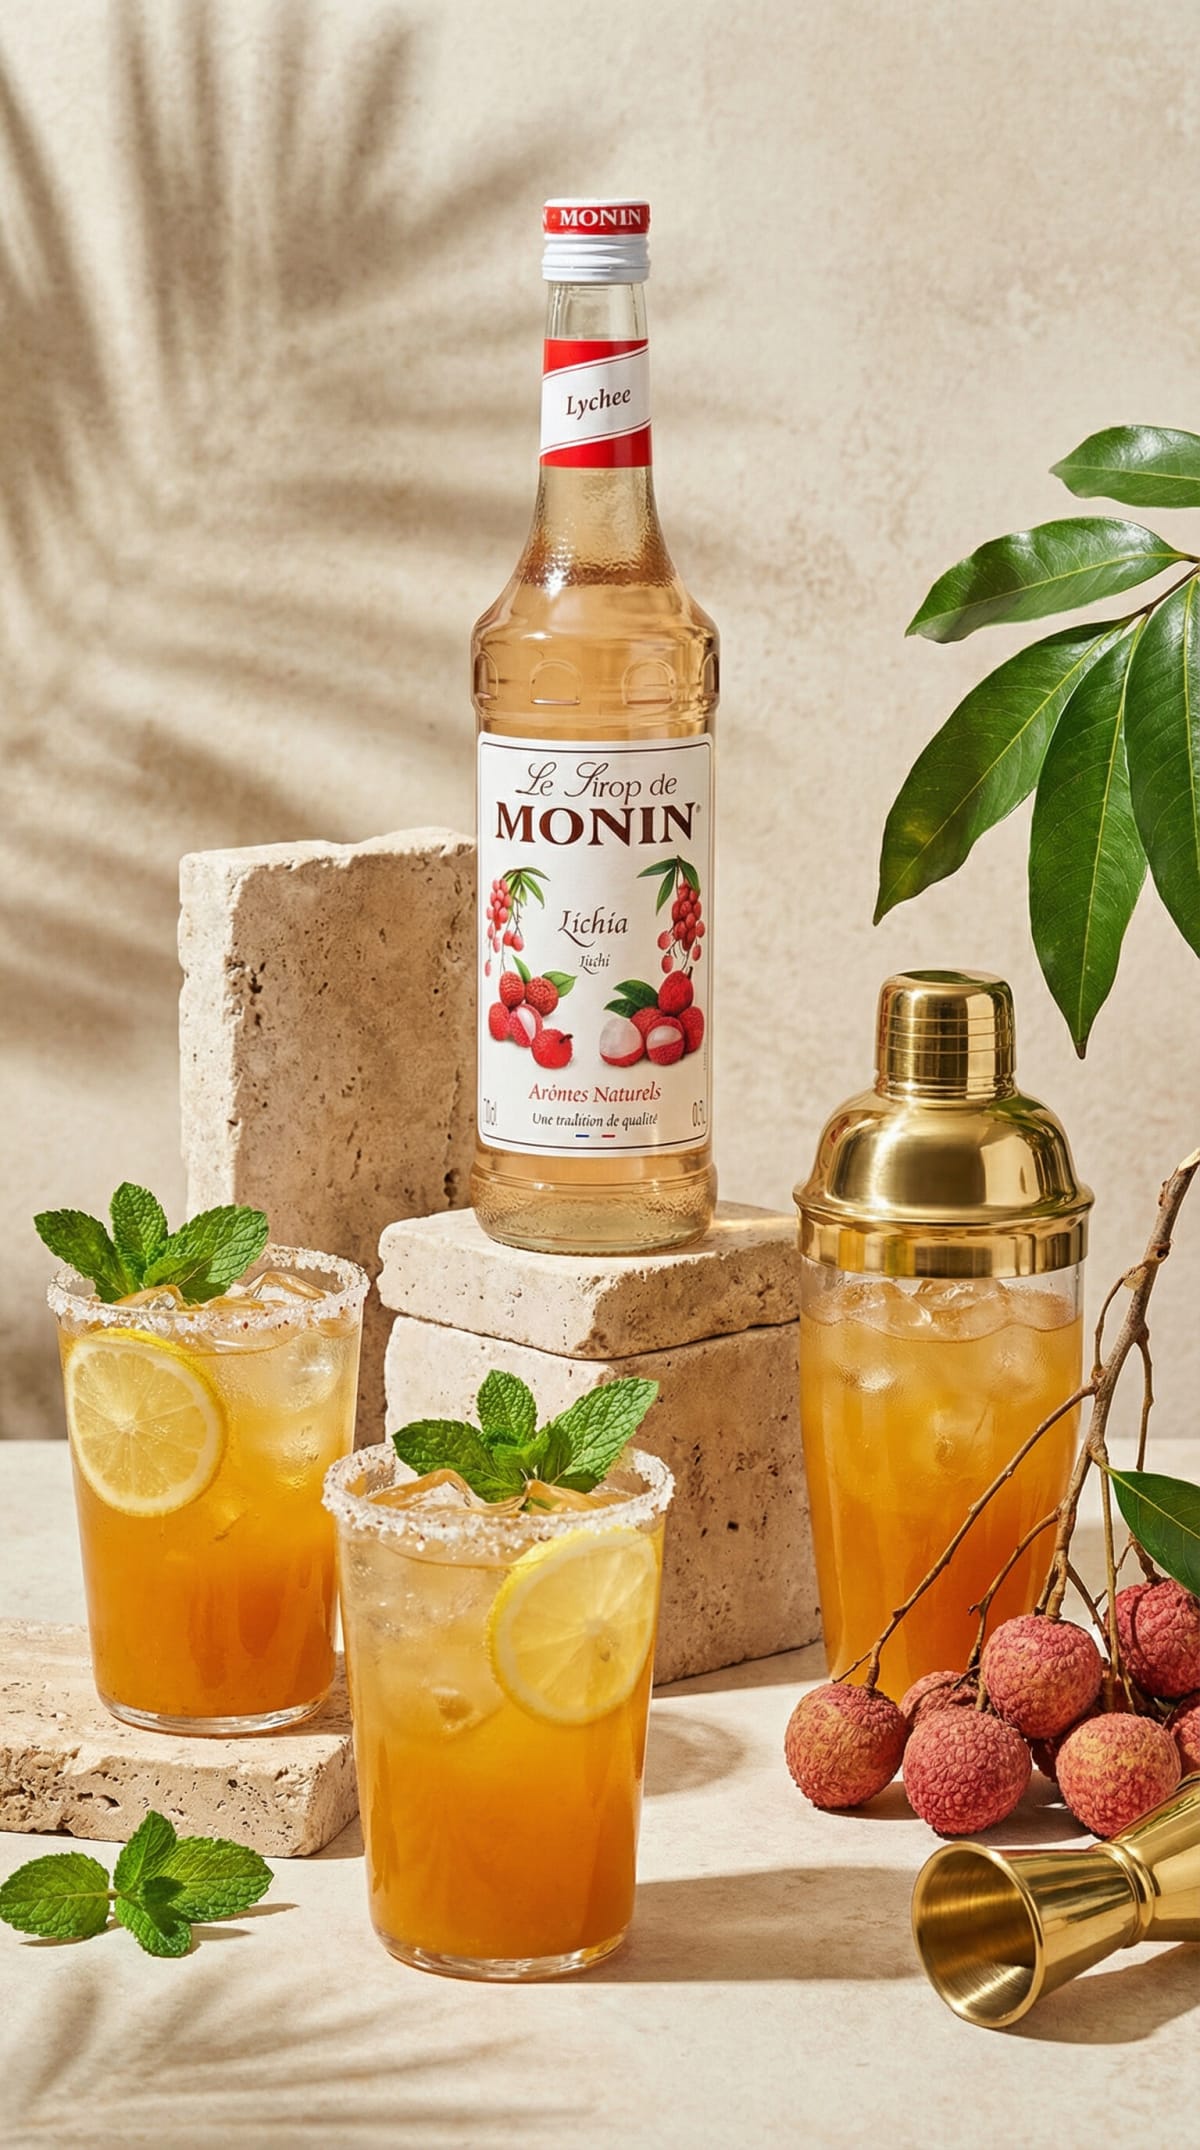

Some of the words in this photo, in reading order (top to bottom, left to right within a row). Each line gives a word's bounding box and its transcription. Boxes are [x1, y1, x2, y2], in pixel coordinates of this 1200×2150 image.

[560, 209, 641, 227] MONIN
[566, 388, 631, 421] Lychee
[515, 762, 557, 797] Le
[564, 761, 642, 805] Sirop
[649, 773, 678, 796] de
[558, 906, 629, 948] Lichia
[593, 1080, 662, 1103] Naturels
[532, 1112, 553, 1126] Une
[556, 1112, 604, 1128] tradition
[606, 1113, 620, 1128] de
[621, 1111, 659, 1132] qualité
